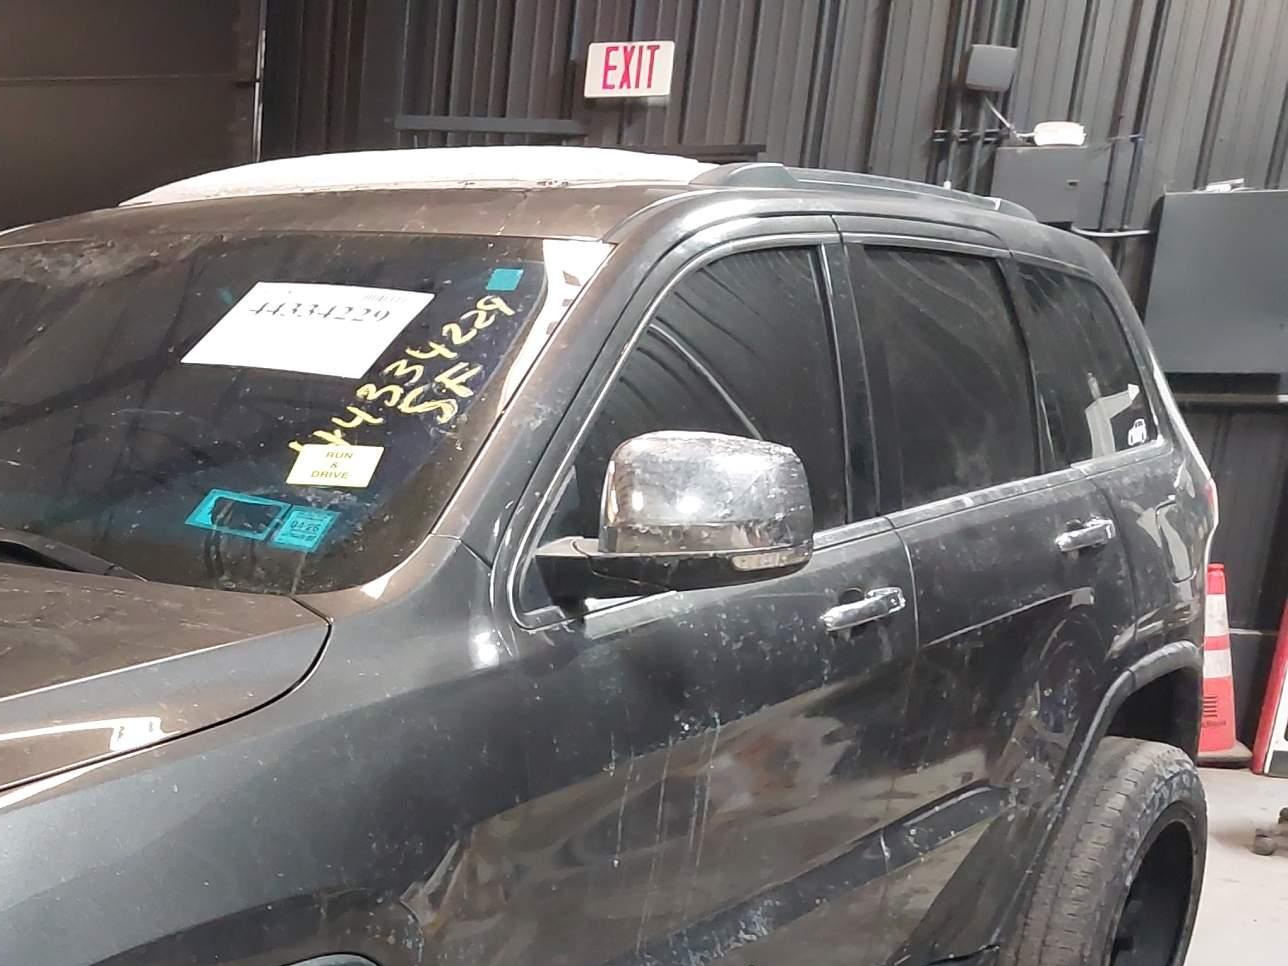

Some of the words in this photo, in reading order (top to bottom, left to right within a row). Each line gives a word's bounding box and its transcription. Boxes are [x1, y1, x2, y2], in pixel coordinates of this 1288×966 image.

[602, 44, 661, 90] EXIT
[247, 301, 391, 323] 44334229
[396, 361, 484, 425] SF
[326, 451, 354, 459] RUN
[310, 470, 350, 479] DRIVE
